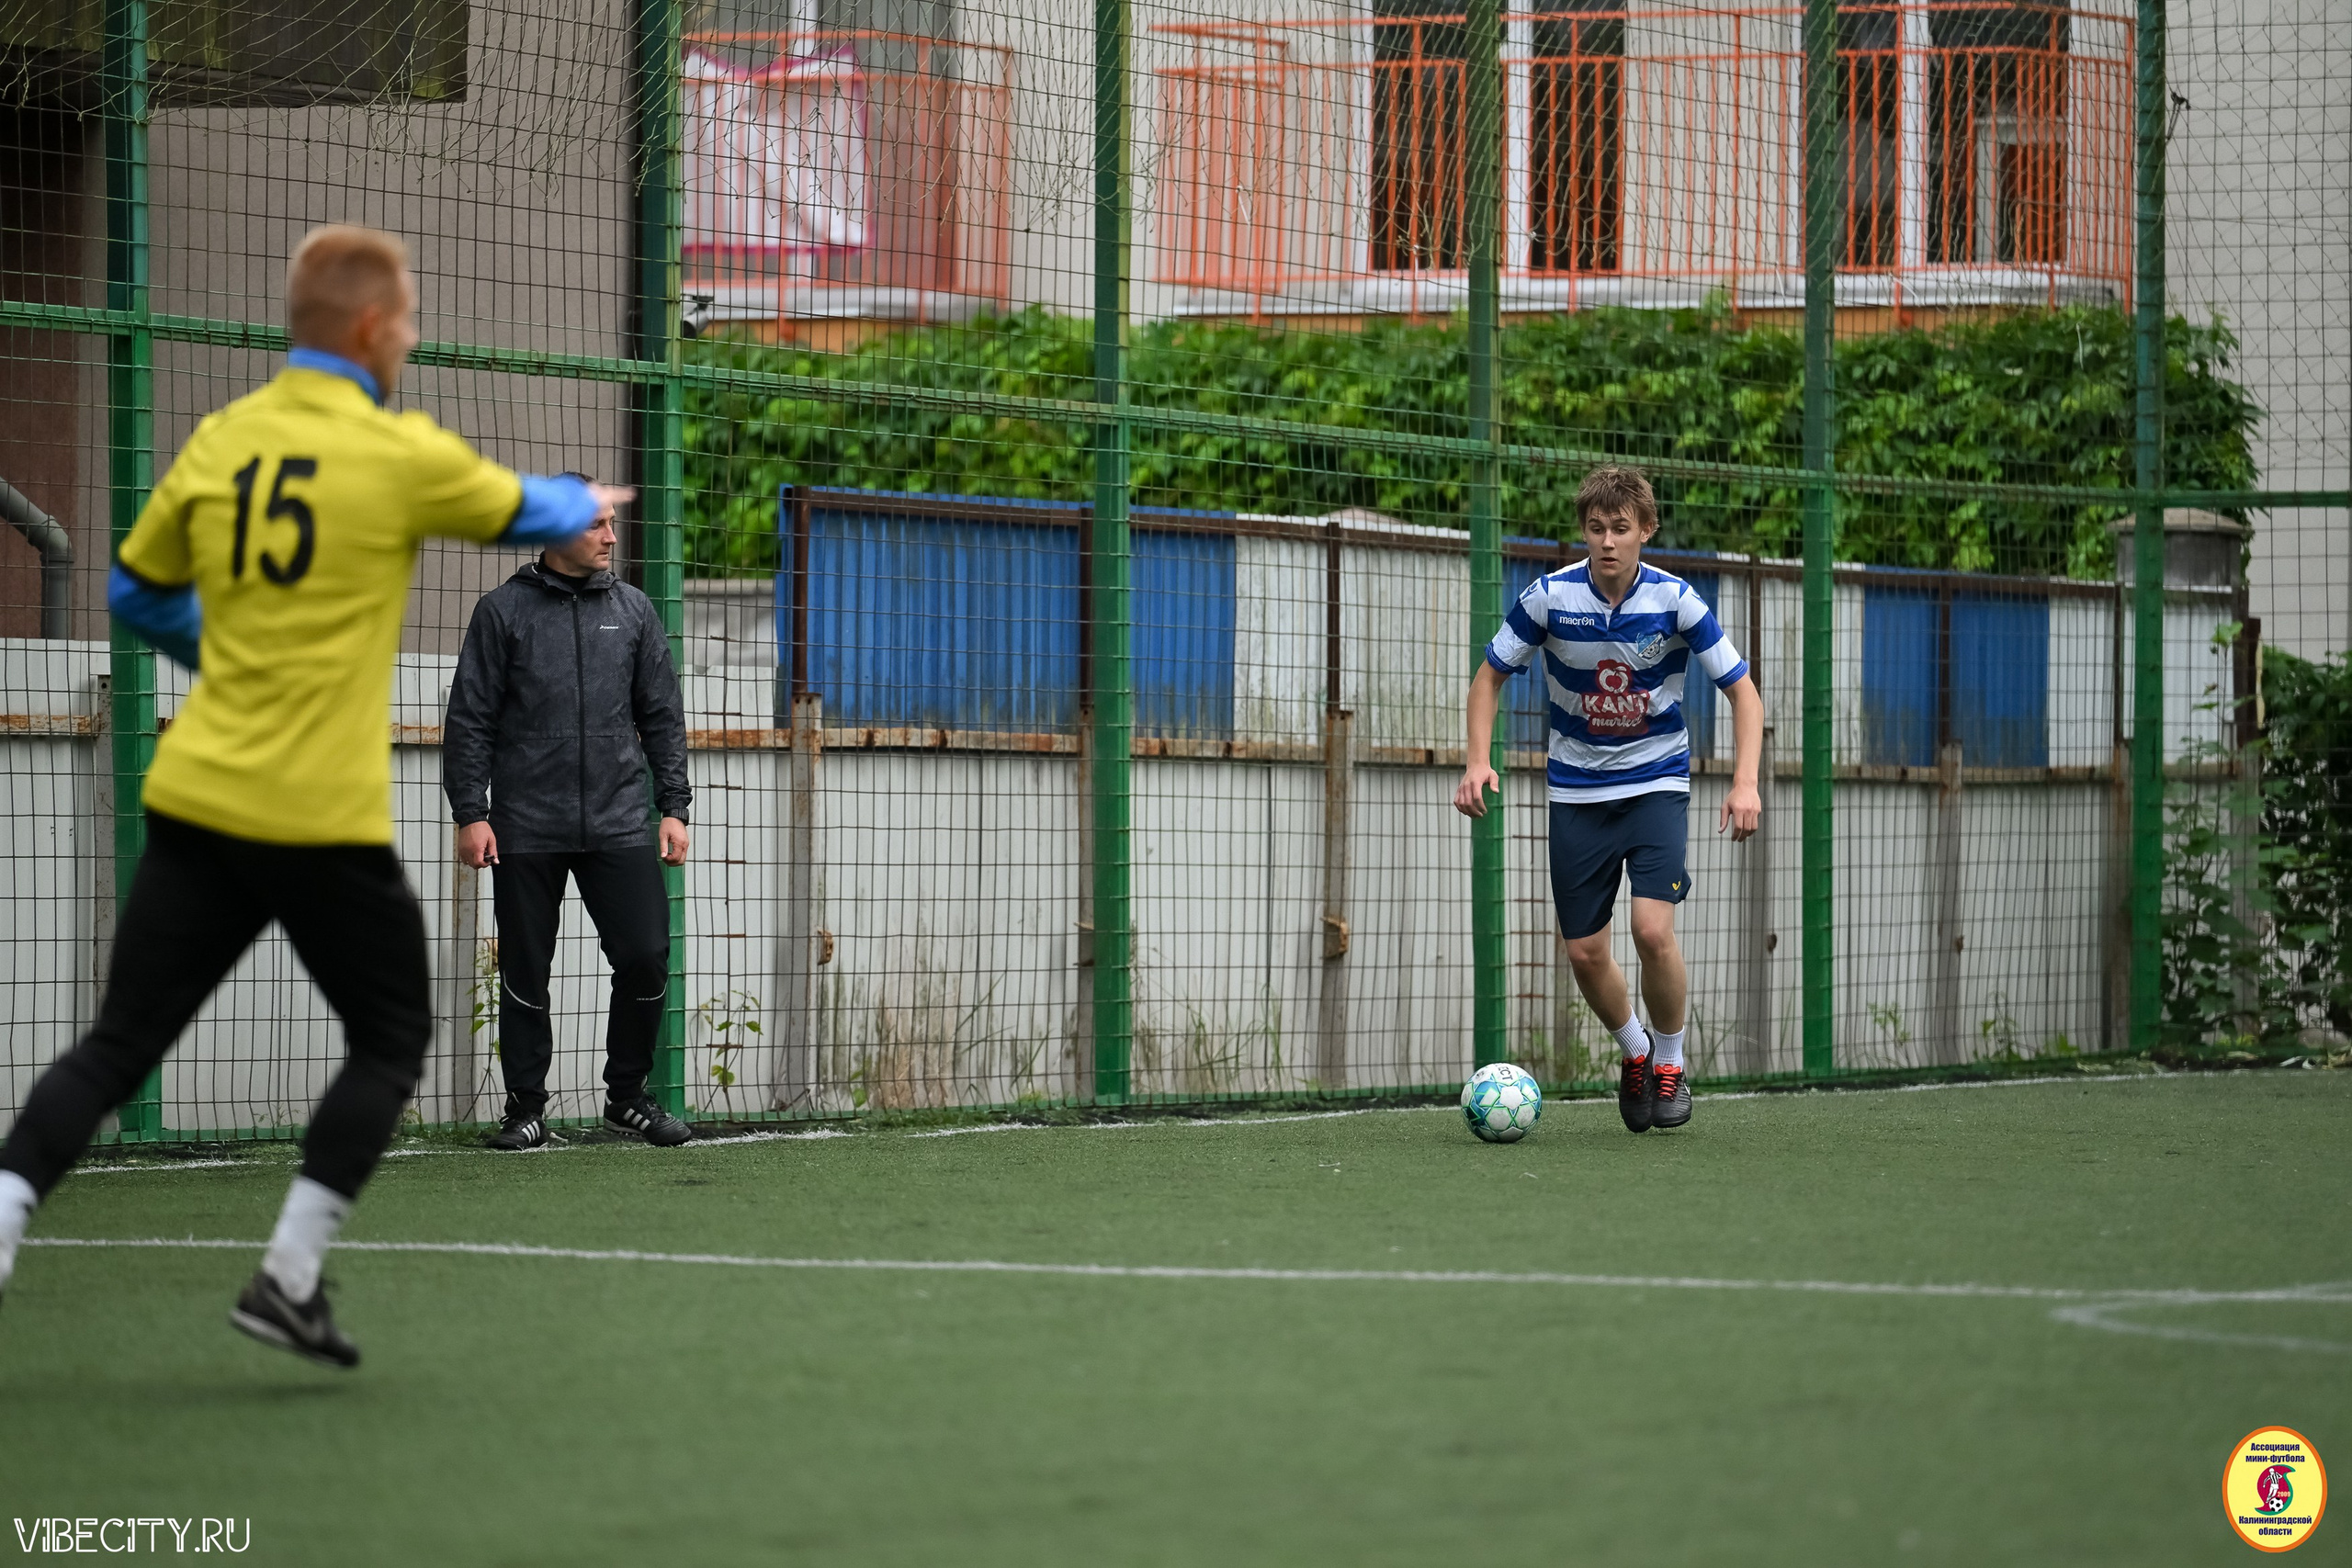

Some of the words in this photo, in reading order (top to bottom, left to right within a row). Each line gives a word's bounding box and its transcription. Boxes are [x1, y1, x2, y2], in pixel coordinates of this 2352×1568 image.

[233, 455, 318, 585] 15
[1559, 616, 1594, 626] macron
[1585, 694, 1646, 713] KANT
